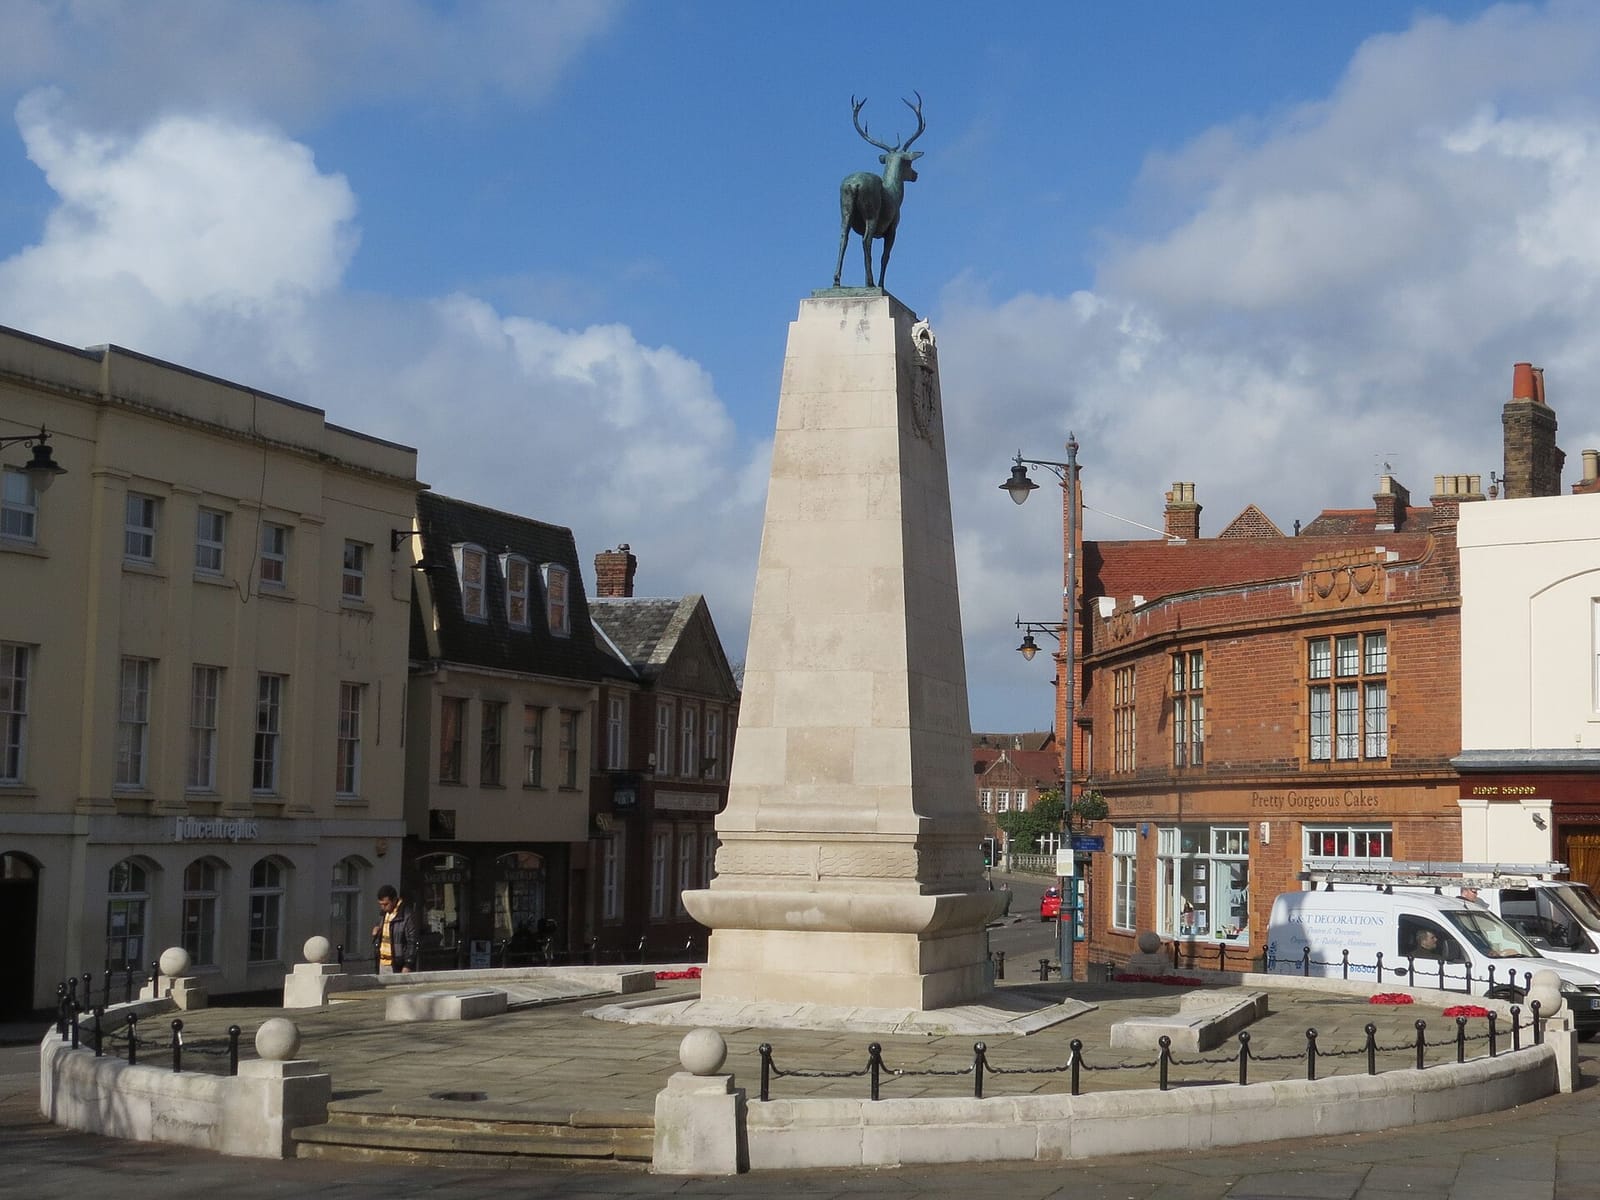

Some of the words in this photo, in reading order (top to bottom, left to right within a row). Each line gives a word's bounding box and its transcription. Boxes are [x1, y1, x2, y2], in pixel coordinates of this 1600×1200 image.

[1472, 786, 1498, 795] 01992
[1251, 791, 1285, 808] Pretty
[1287, 790, 1340, 810] Gorgeous
[1343, 790, 1379, 807] Cakes
[1307, 914, 1314, 924] T
[1314, 914, 1384, 926] DECORATIONS
